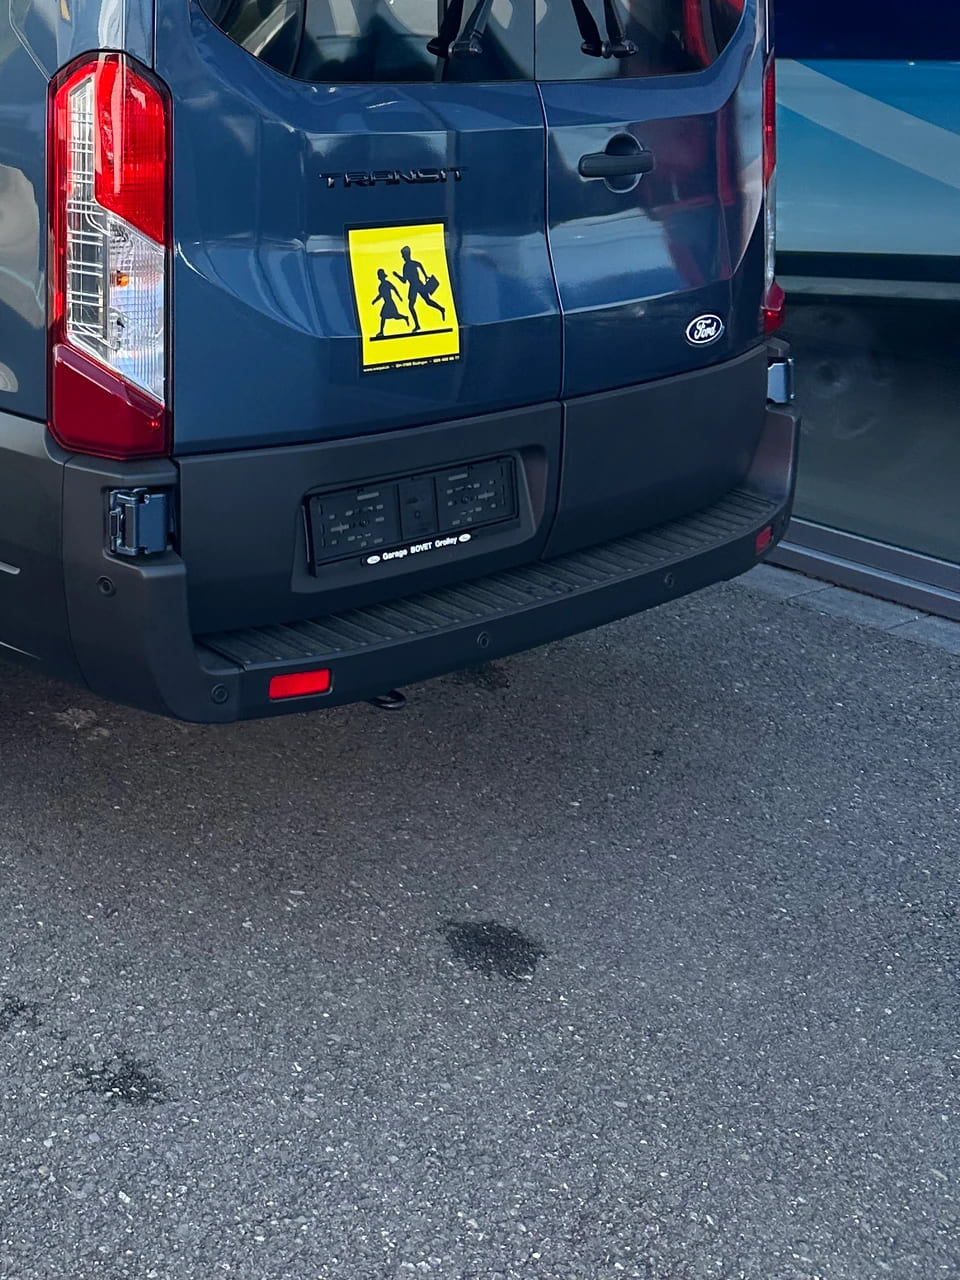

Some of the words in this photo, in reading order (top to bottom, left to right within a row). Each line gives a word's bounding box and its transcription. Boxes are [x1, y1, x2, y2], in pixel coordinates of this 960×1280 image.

[319, 166, 467, 188] TRANSIT
[383, 549, 407, 560] Garage
[411, 542, 432, 553] BOVET
